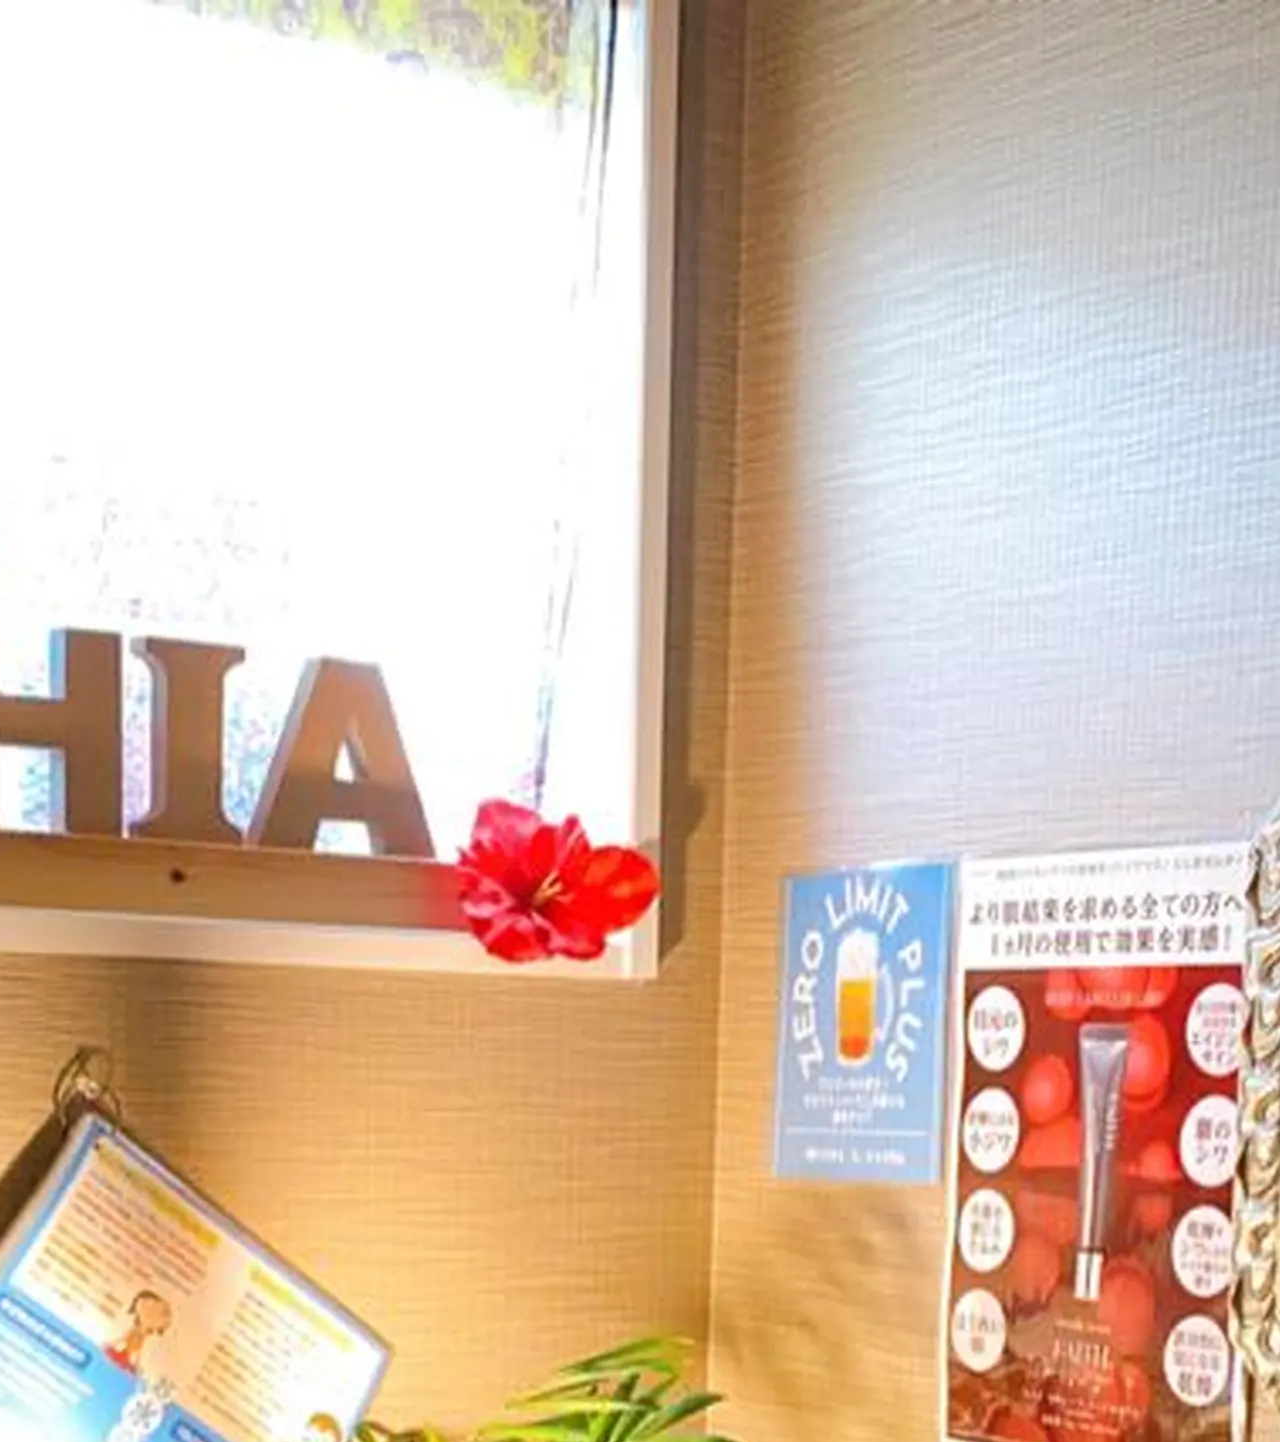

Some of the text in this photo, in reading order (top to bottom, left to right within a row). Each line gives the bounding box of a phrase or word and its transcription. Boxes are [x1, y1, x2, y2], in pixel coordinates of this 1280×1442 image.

[792, 875, 926, 1083] ZERO LIMIT PLUS
